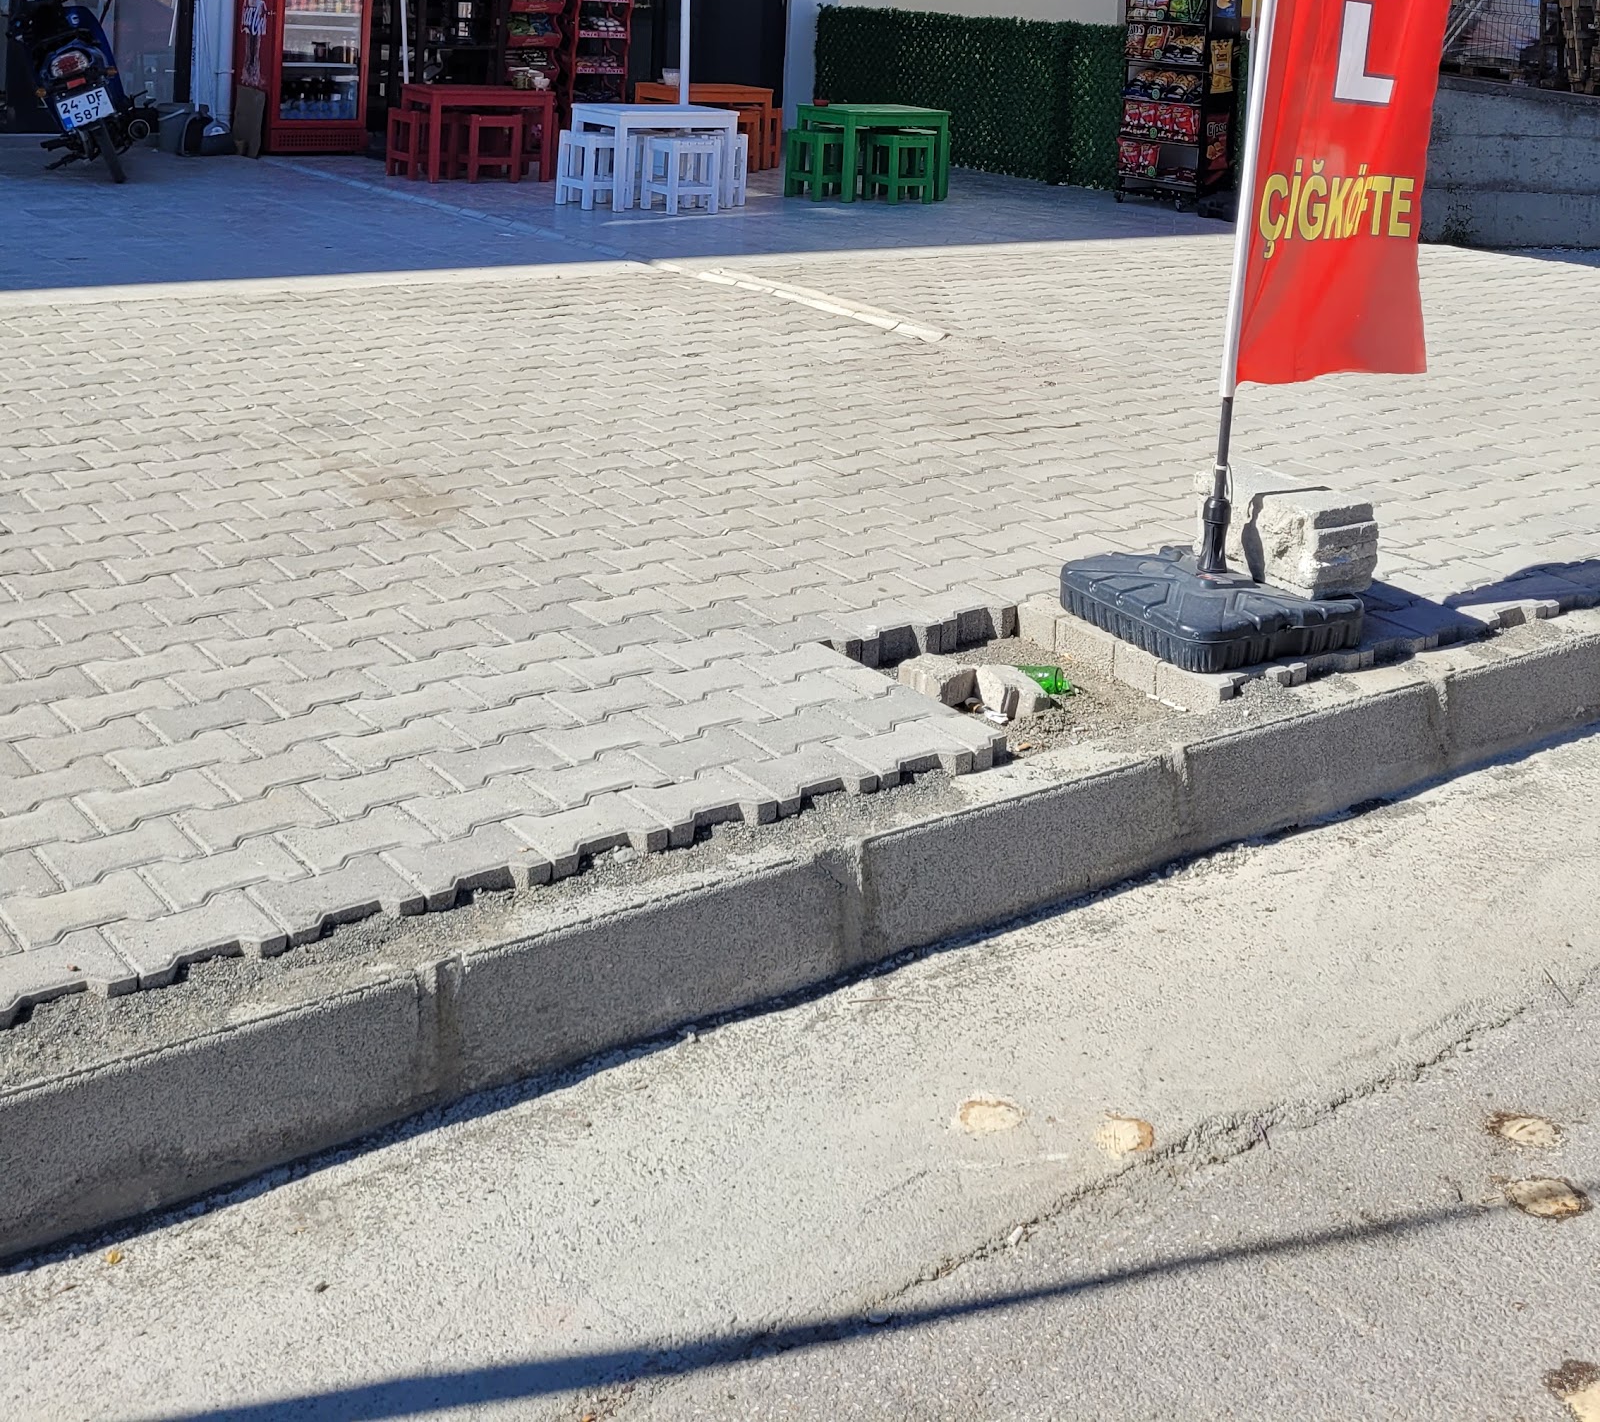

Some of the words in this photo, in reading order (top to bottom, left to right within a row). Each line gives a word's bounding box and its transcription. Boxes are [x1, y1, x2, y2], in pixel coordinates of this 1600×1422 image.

[61, 100, 78, 114] 24
[74, 106, 99, 123] 587
[1259, 158, 1415, 259] ÇİĞKÖFTE
